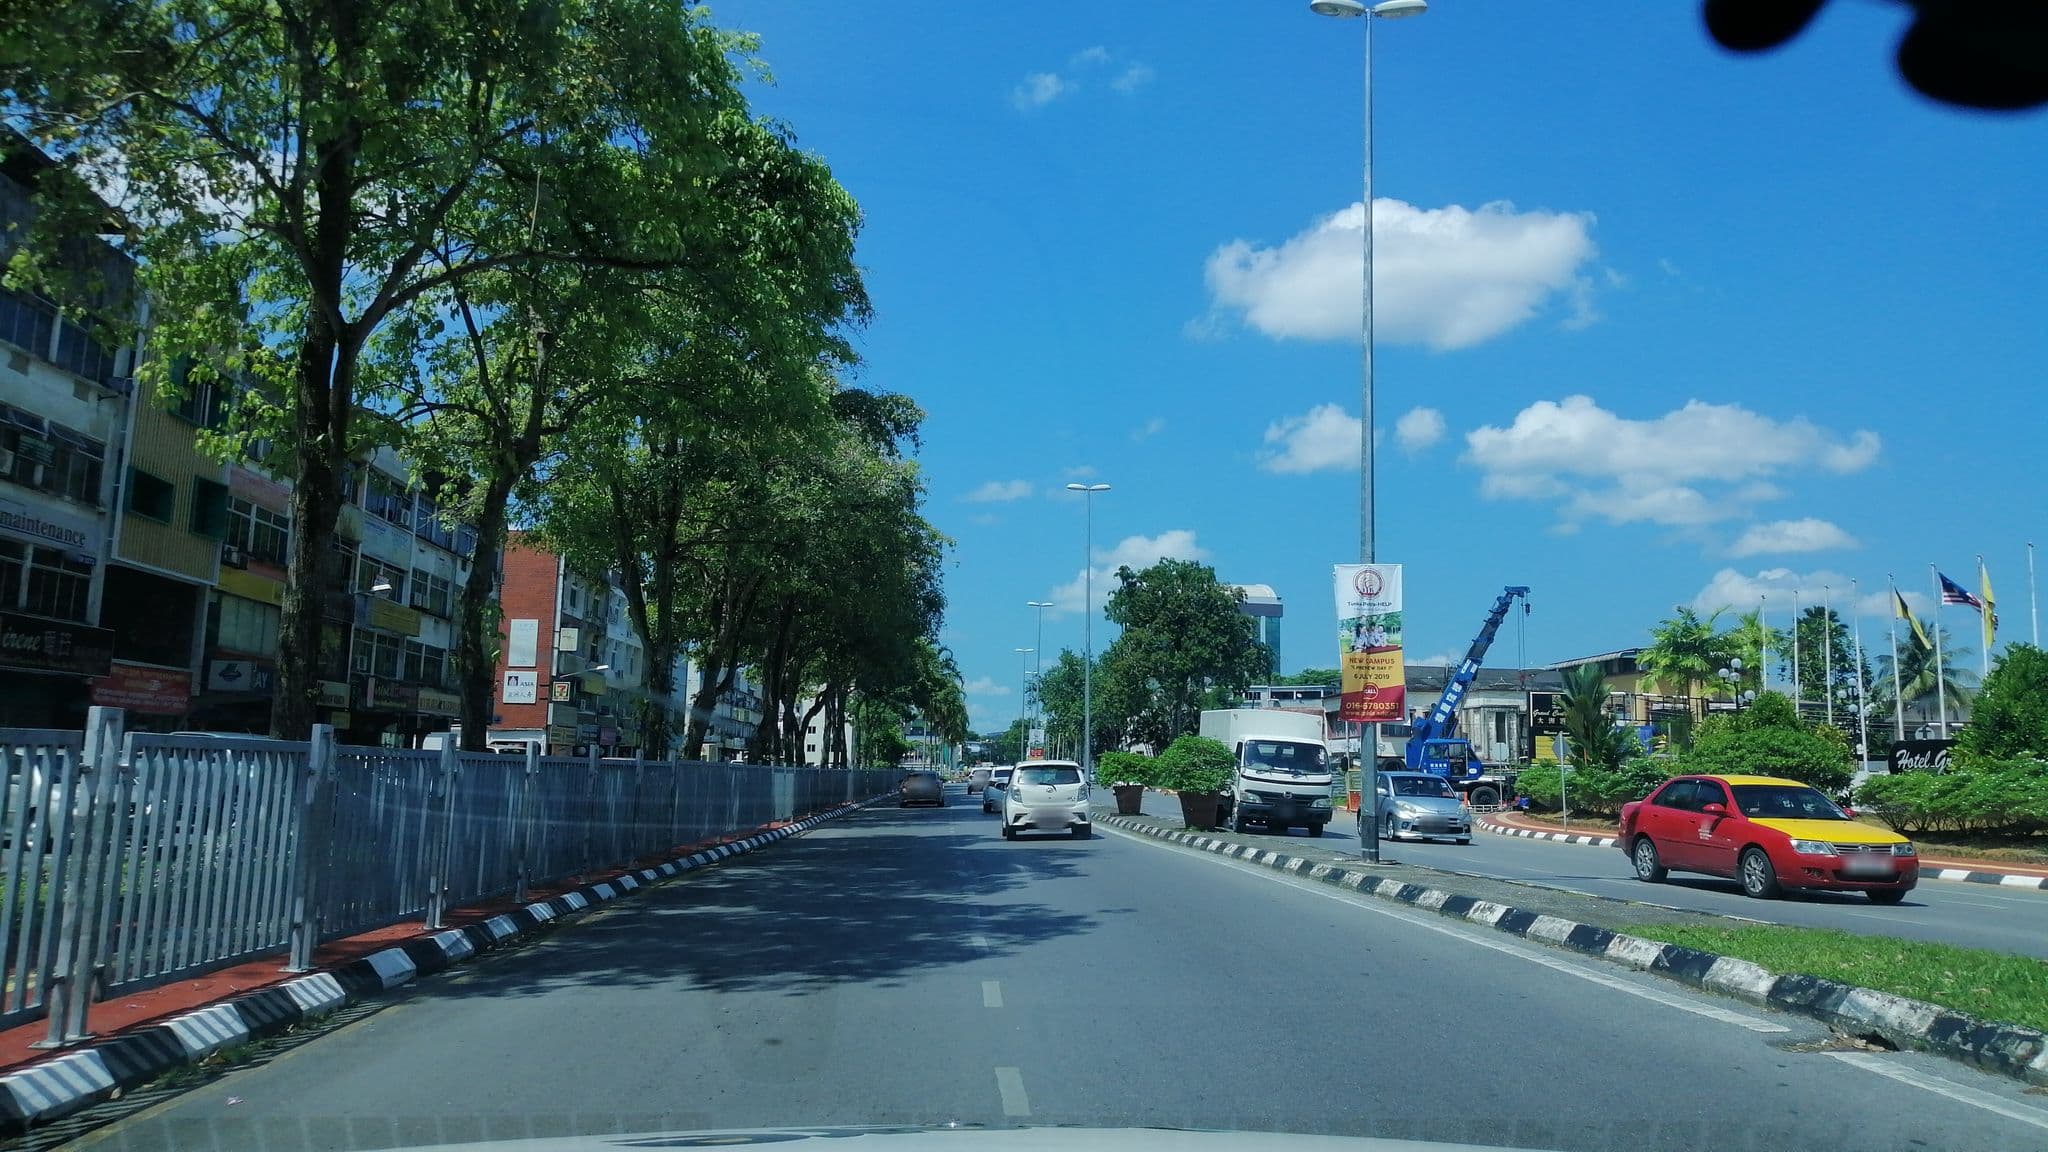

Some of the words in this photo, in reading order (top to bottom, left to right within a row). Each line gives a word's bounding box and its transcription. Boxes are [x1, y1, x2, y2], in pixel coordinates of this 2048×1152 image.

[0, 511, 86, 546] maintenance
[1349, 656, 1364, 664] NEW
[1366, 657, 1396, 665] CAMPUS
[1895, 749, 1932, 769] Hotel
